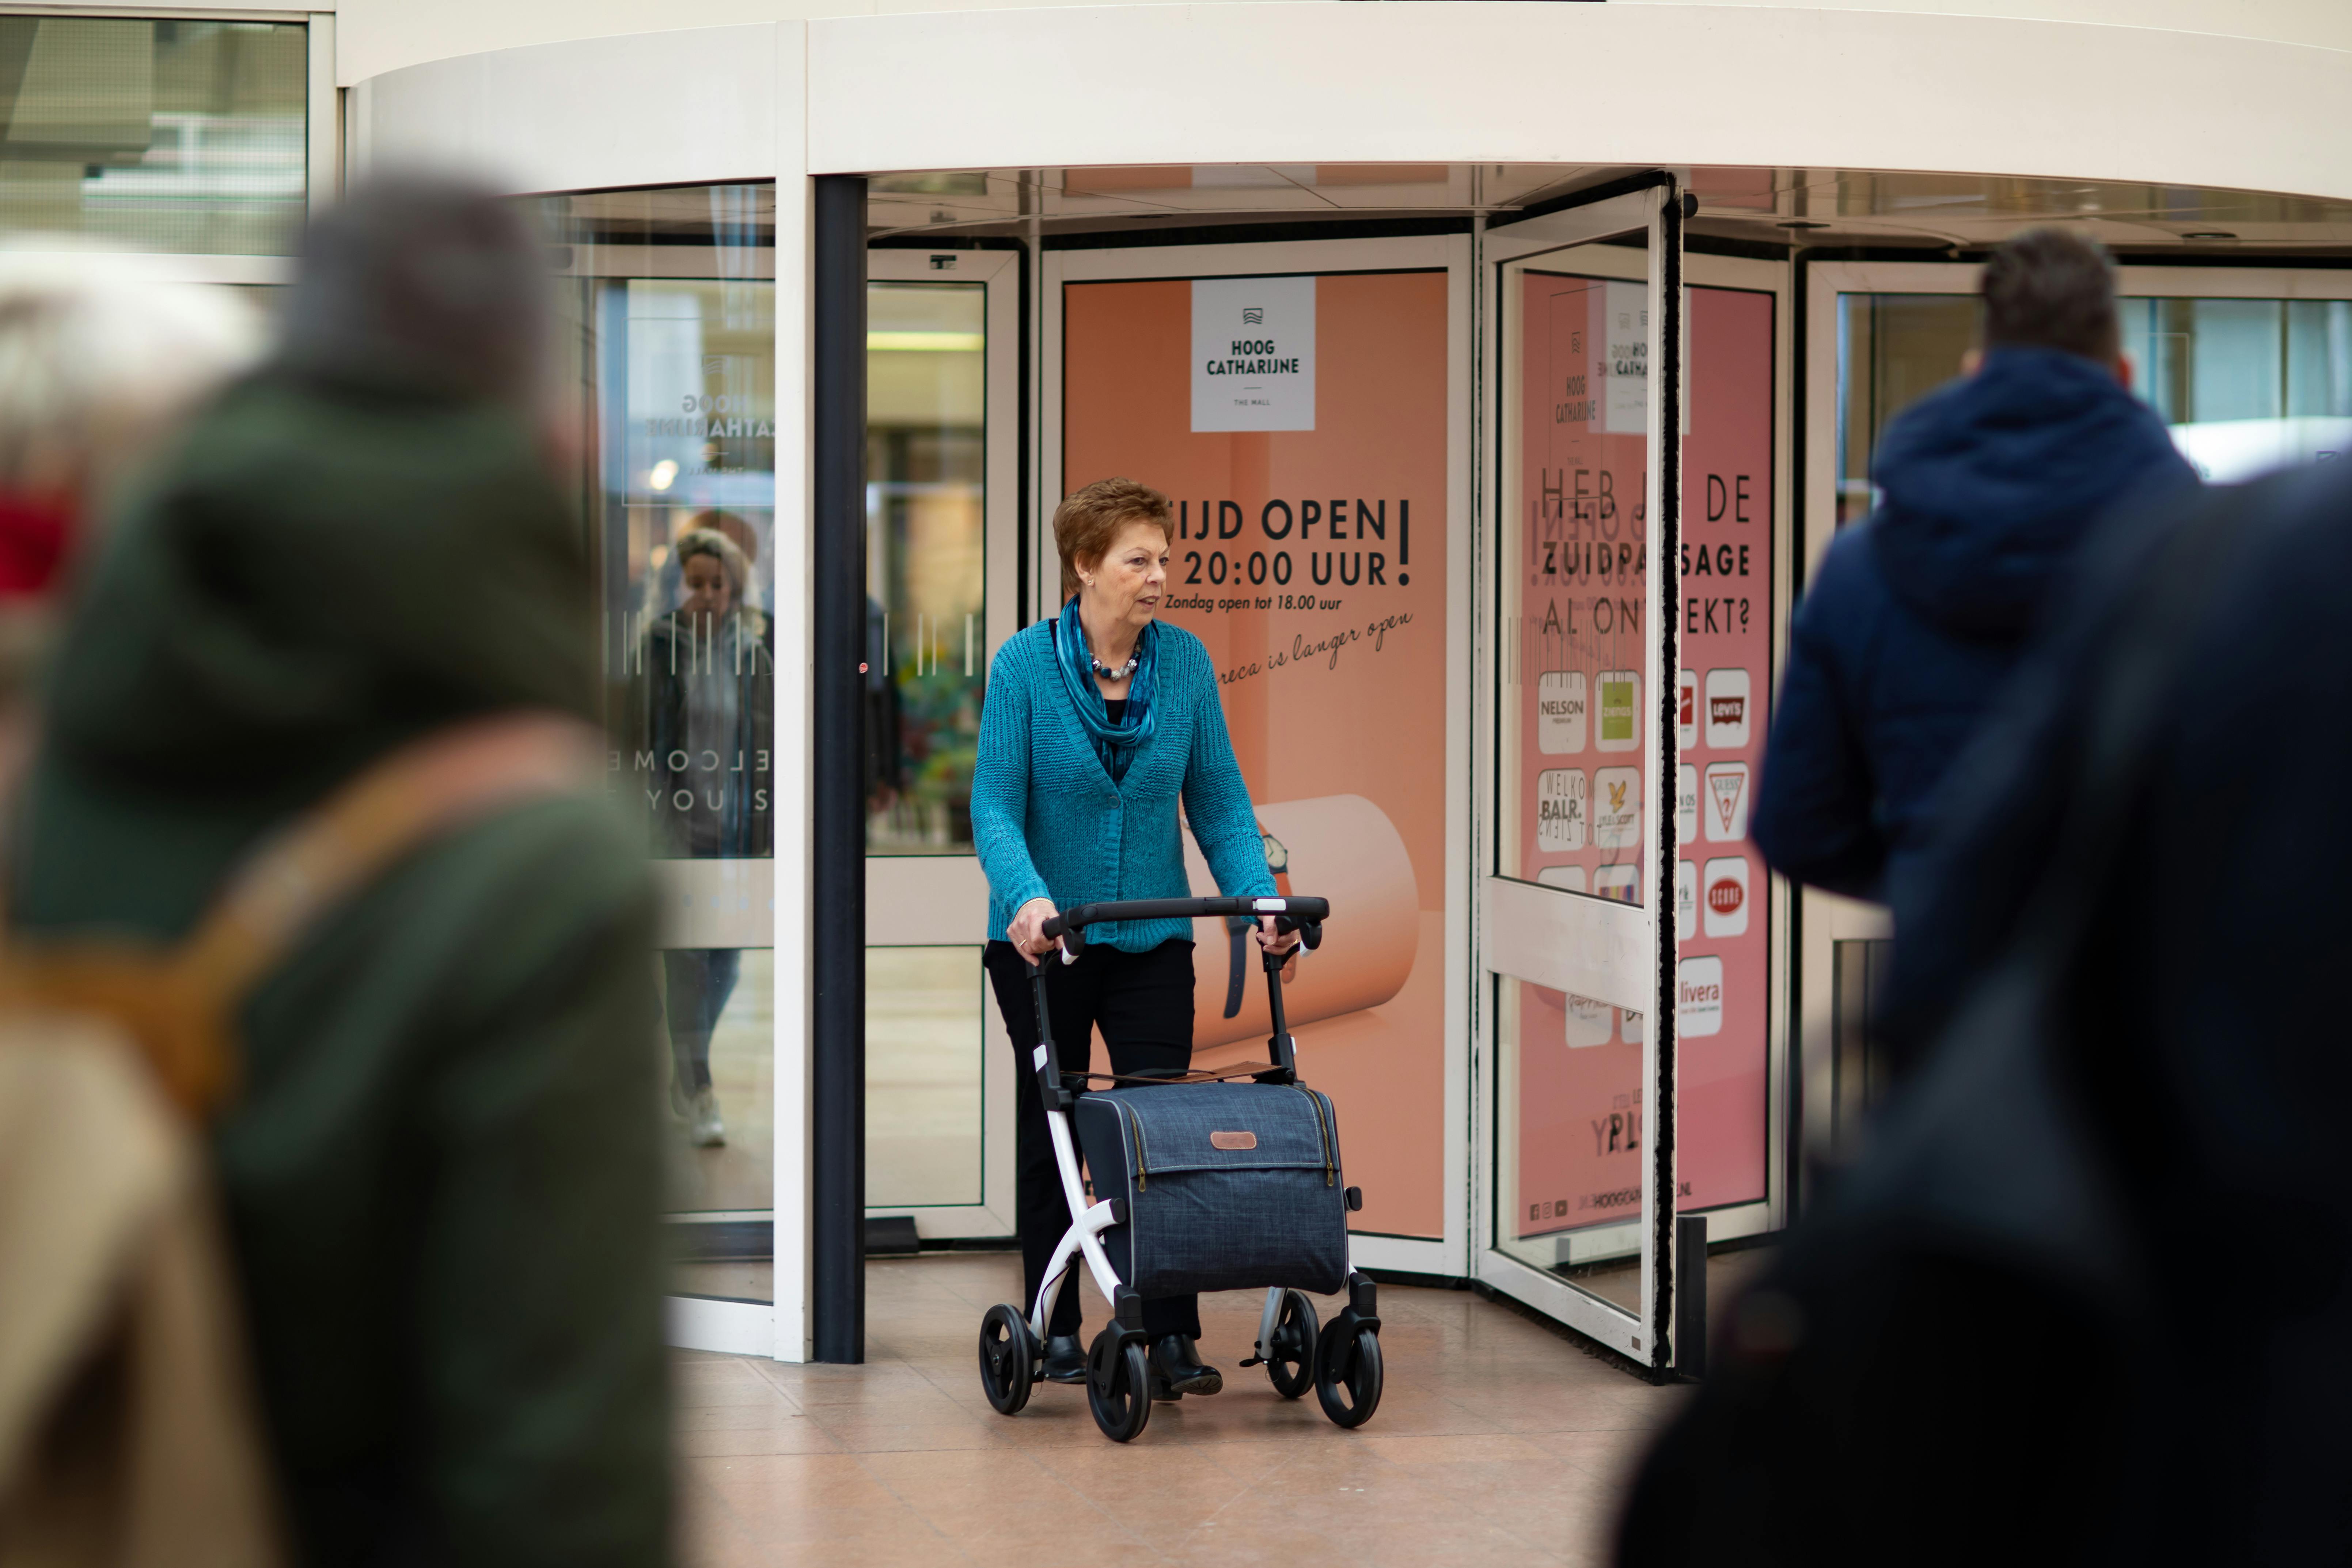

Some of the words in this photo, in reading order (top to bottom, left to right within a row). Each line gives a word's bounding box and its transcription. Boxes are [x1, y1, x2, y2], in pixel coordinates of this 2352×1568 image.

[1232, 340, 1275, 355] HOOG
[1207, 358, 1299, 375] CATHARIJNE
[1567, 375, 1585, 396] HOOG
[1556, 400, 1595, 424] CATHARIJNE
[1542, 468, 1615, 520] HEB
[1707, 474, 1750, 523] DE
[1168, 500, 1243, 540] IJD
[1261, 498, 1385, 540] OPEN
[1184, 551, 1292, 585] 20:00
[1311, 552, 1387, 585] UUR
[1542, 542, 1749, 576] ZUIDPASAGE
[1164, 593, 1214, 613] Zondag
[1218, 598, 1250, 613] open
[1255, 596, 1272, 610] tot
[1278, 595, 1316, 610] 18.00
[1320, 599, 1342, 610] uur
[1542, 597, 1577, 634] AL
[1217, 662, 1262, 684] reca
[1268, 652, 1289, 669] is
[1293, 634, 1361, 671] langer
[1367, 613, 1413, 652] open
[1541, 701, 1584, 715] NELSON
[1546, 771, 1594, 801] WELKOM
[646, 789, 723, 811] YOU
[1541, 798, 1582, 820] BALR.
[1681, 981, 1719, 1002] livera
